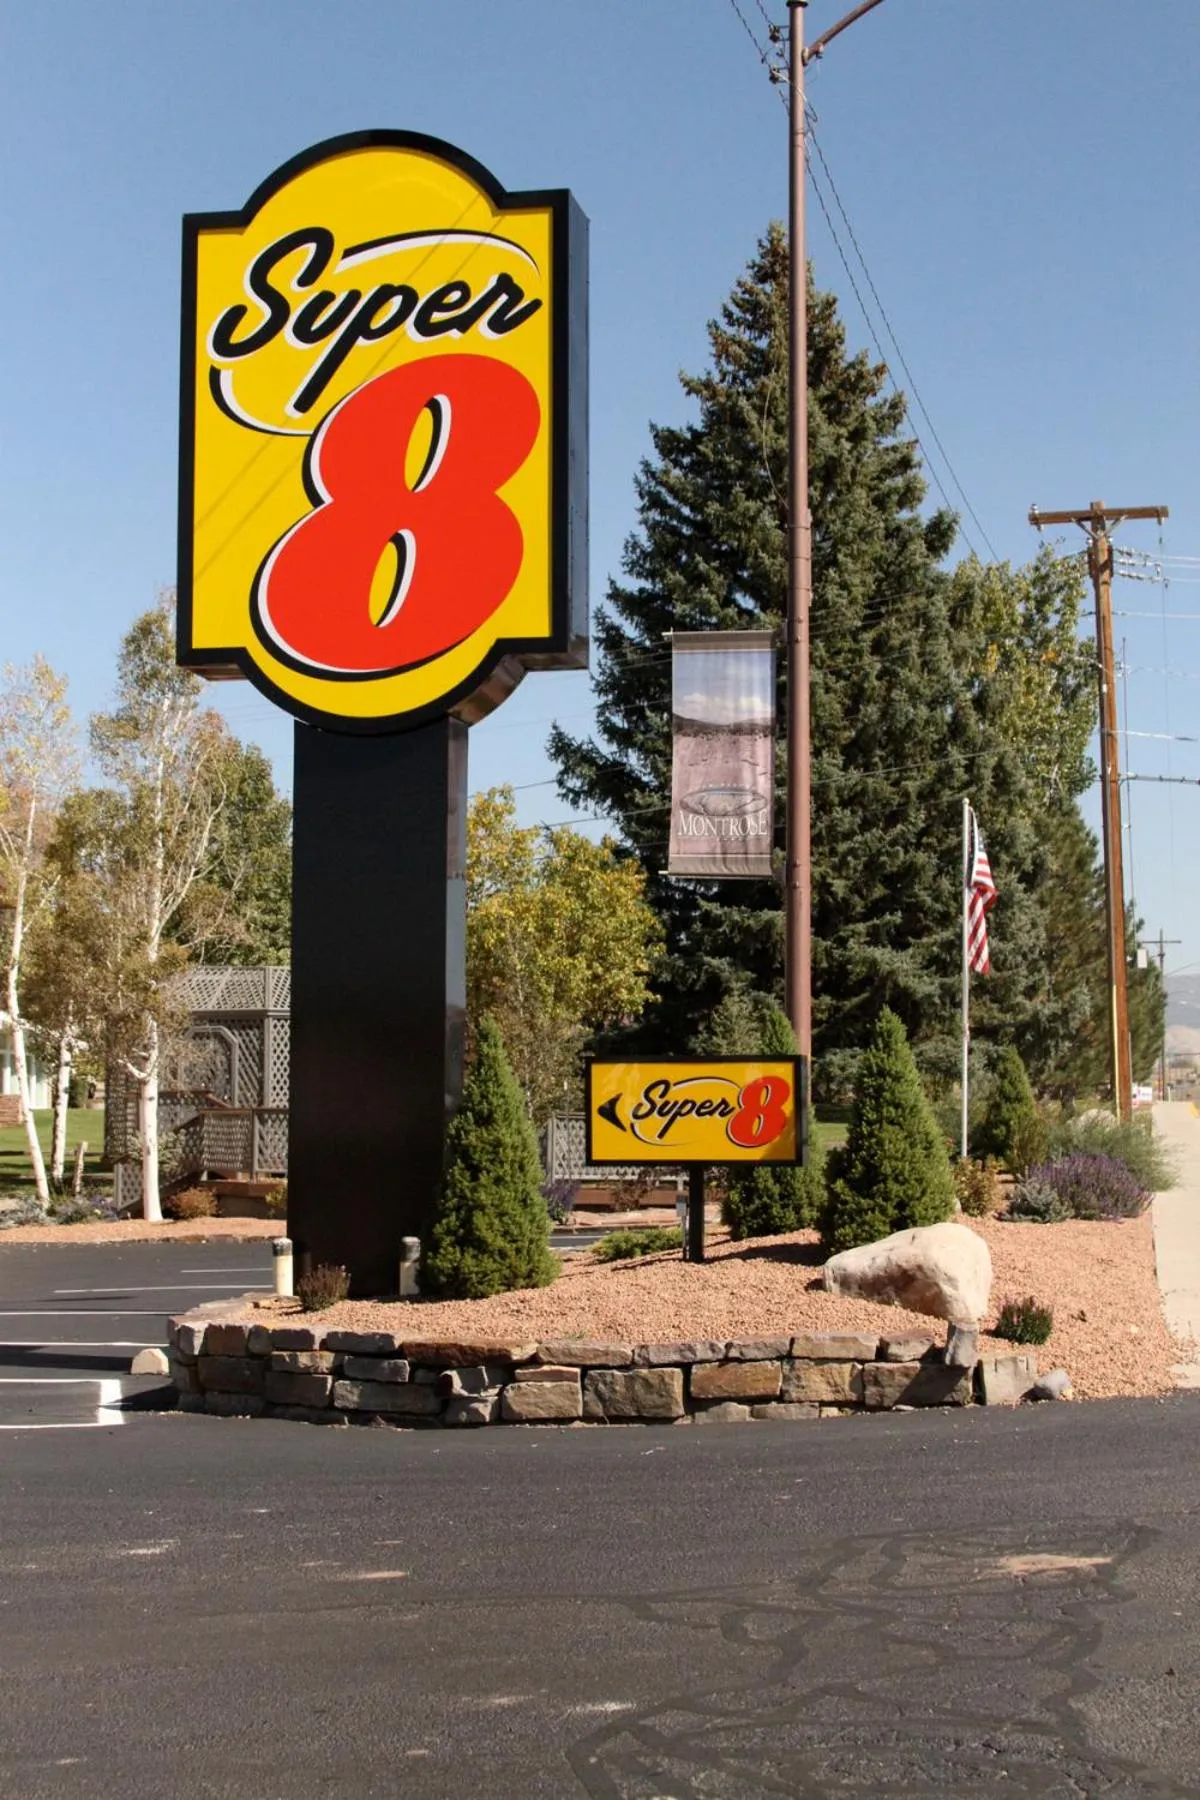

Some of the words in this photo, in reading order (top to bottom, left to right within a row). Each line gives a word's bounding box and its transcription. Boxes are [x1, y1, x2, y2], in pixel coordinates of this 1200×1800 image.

[207, 226, 543, 417] Super
[248, 353, 542, 682] 8
[678, 810, 767, 836] MONTROSE
[630, 1079, 736, 1142] Super
[726, 1075, 791, 1148] 8
